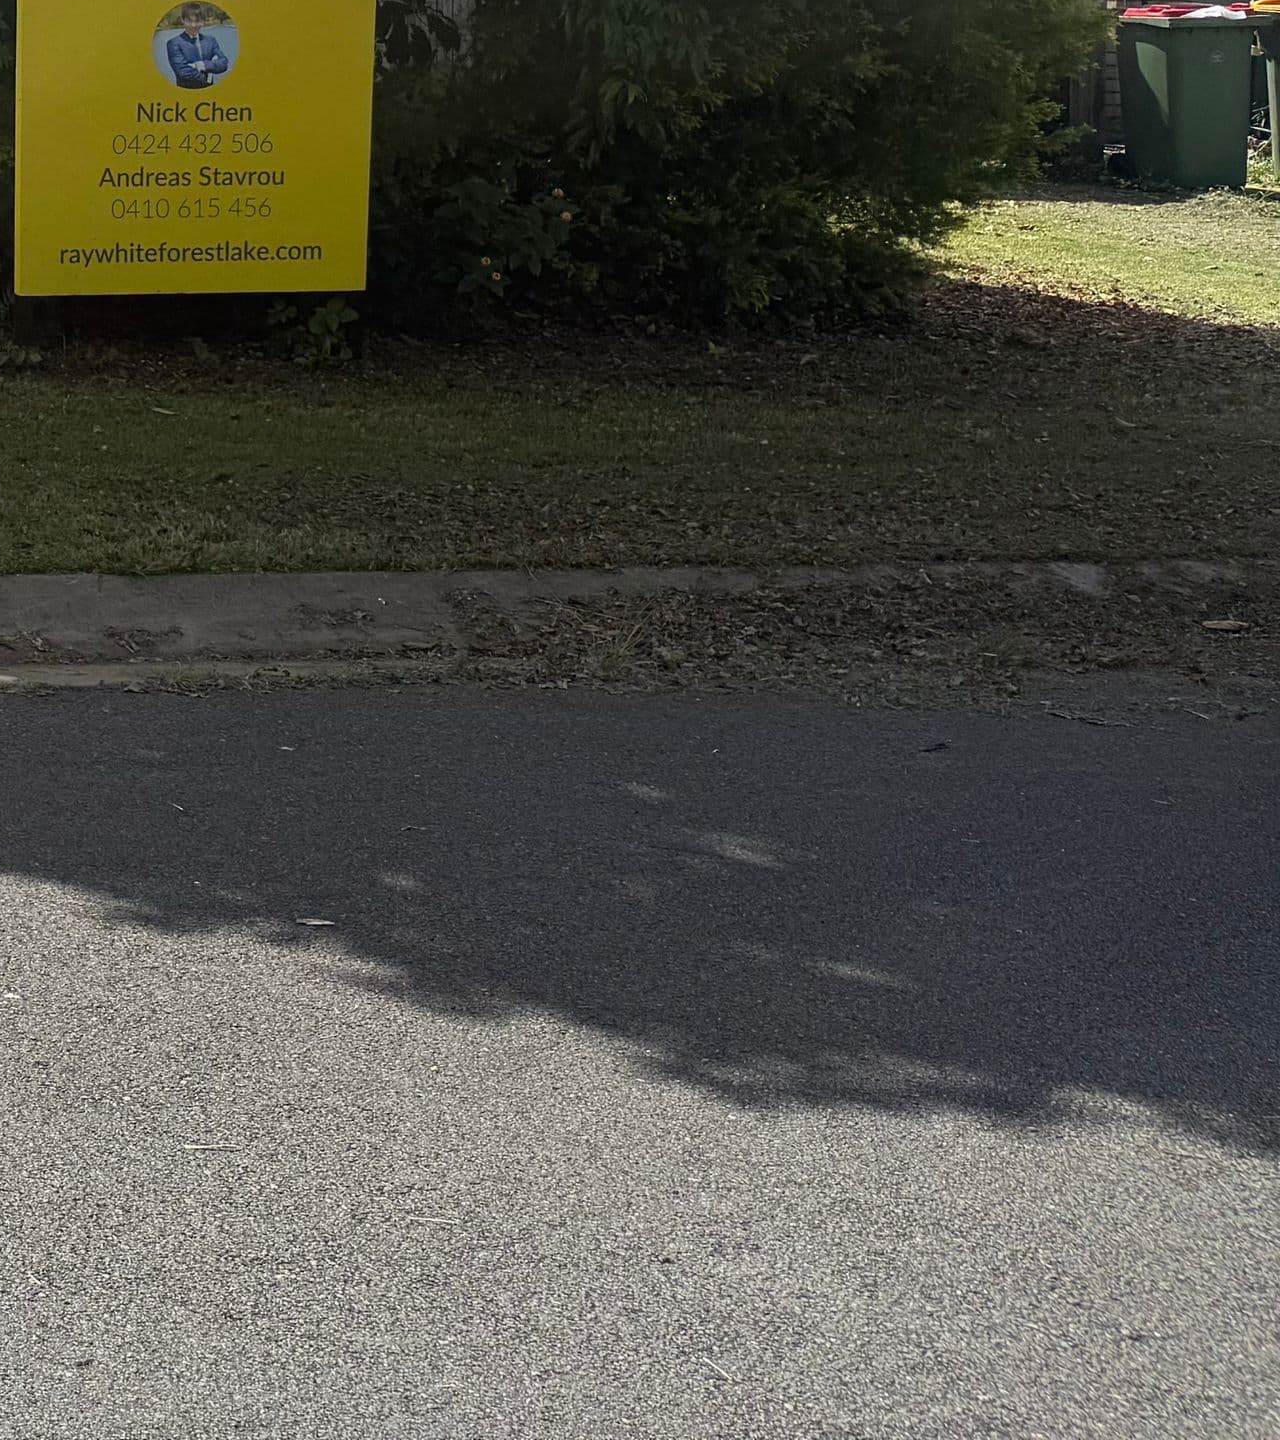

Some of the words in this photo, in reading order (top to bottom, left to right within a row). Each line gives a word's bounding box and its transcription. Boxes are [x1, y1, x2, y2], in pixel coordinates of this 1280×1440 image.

[137, 102, 187, 123] Nick
[194, 101, 252, 122] Chen
[112, 134, 171, 155] 0424
[178, 133, 222, 154] 432
[231, 133, 273, 153] 506
[99, 166, 191, 187] Andreas
[199, 166, 285, 186] Stavrou
[111, 198, 170, 219] 0410
[178, 198, 220, 218] 615
[228, 197, 272, 218] 456
[59, 240, 322, 268] raywhiteforestlake.com
